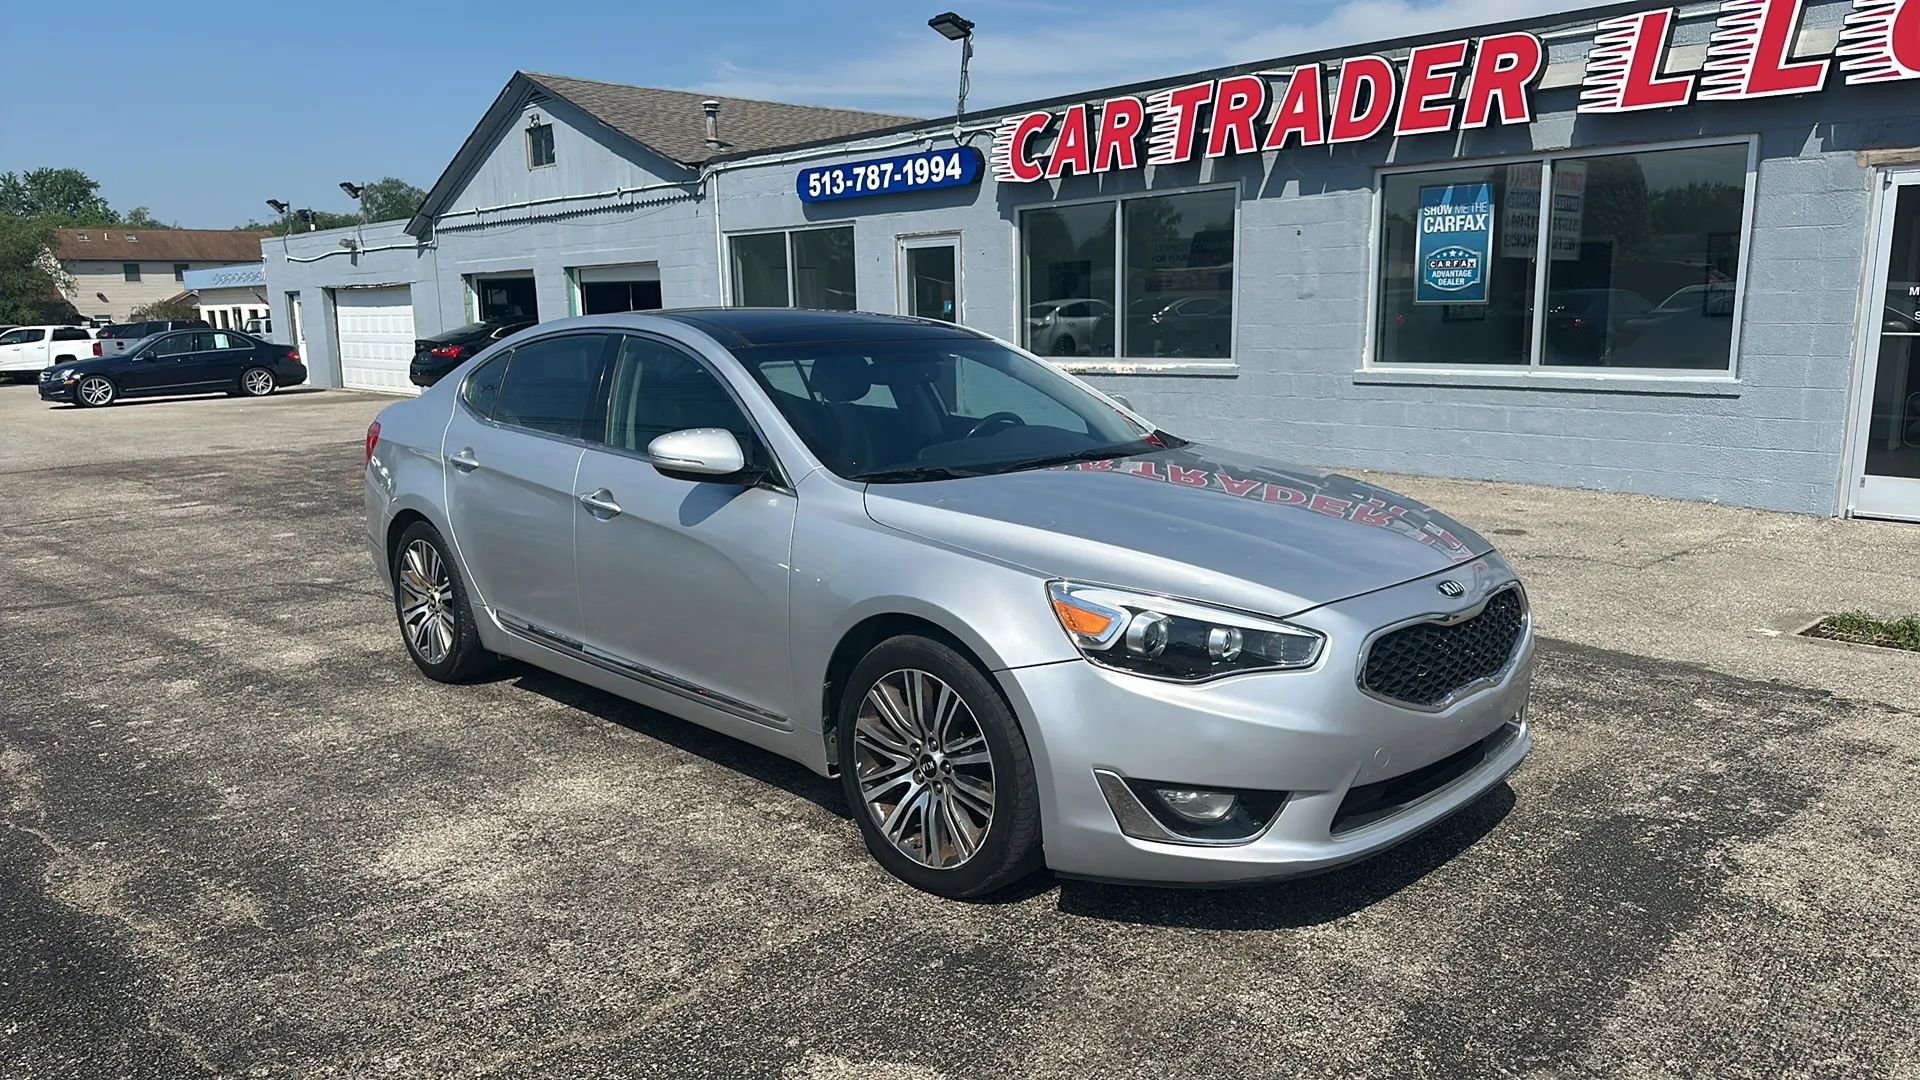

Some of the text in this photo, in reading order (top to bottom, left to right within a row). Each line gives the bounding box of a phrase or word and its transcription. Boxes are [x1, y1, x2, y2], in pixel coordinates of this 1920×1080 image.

[992, 96, 1143, 183] CAR
[1147, 31, 1543, 165] TRADER
[808, 152, 962, 198] 513-787-1994
[1423, 204, 1453, 216] SHOW
[1454, 203, 1468, 214] ME
[1470, 201, 1488, 213] THE
[1423, 213, 1487, 233] CARFAX
[1429, 259, 1476, 269] CARFAX
[1431, 269, 1473, 278] ADVANTAGE
[1437, 277, 1466, 286] DEALER
[1439, 581, 1464, 596] KIA
